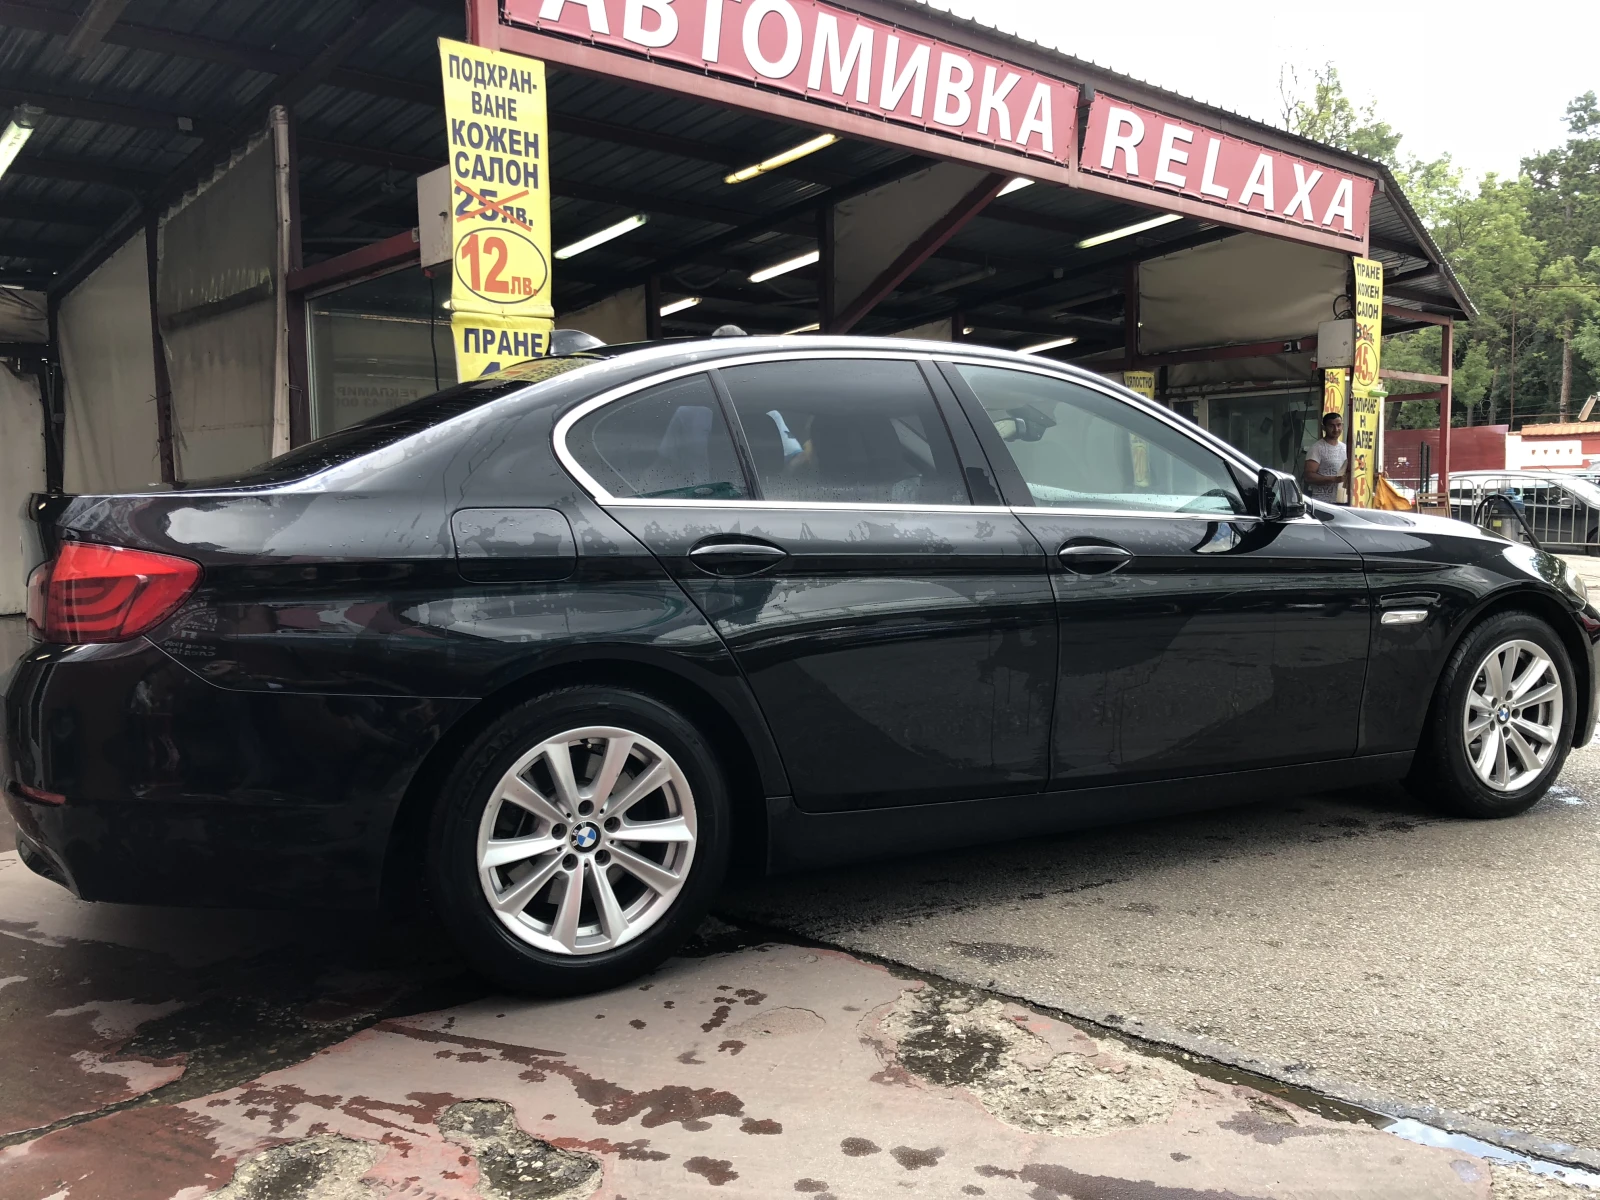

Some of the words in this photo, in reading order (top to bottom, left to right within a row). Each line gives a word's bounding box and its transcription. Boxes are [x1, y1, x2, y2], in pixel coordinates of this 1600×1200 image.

[448, 54, 538, 95] ПОДХРАН-
[471, 90, 518, 122] ВАНЕ
[451, 118, 540, 160] КОЖЕН
[454, 151, 539, 190] САЛОН
[1100, 106, 1354, 231] RELAXA
[1356, 263, 1380, 280] ПРАНЕ
[1356, 301, 1379, 320] САЛОН
[464, 328, 545, 358] ПРАНЕ
